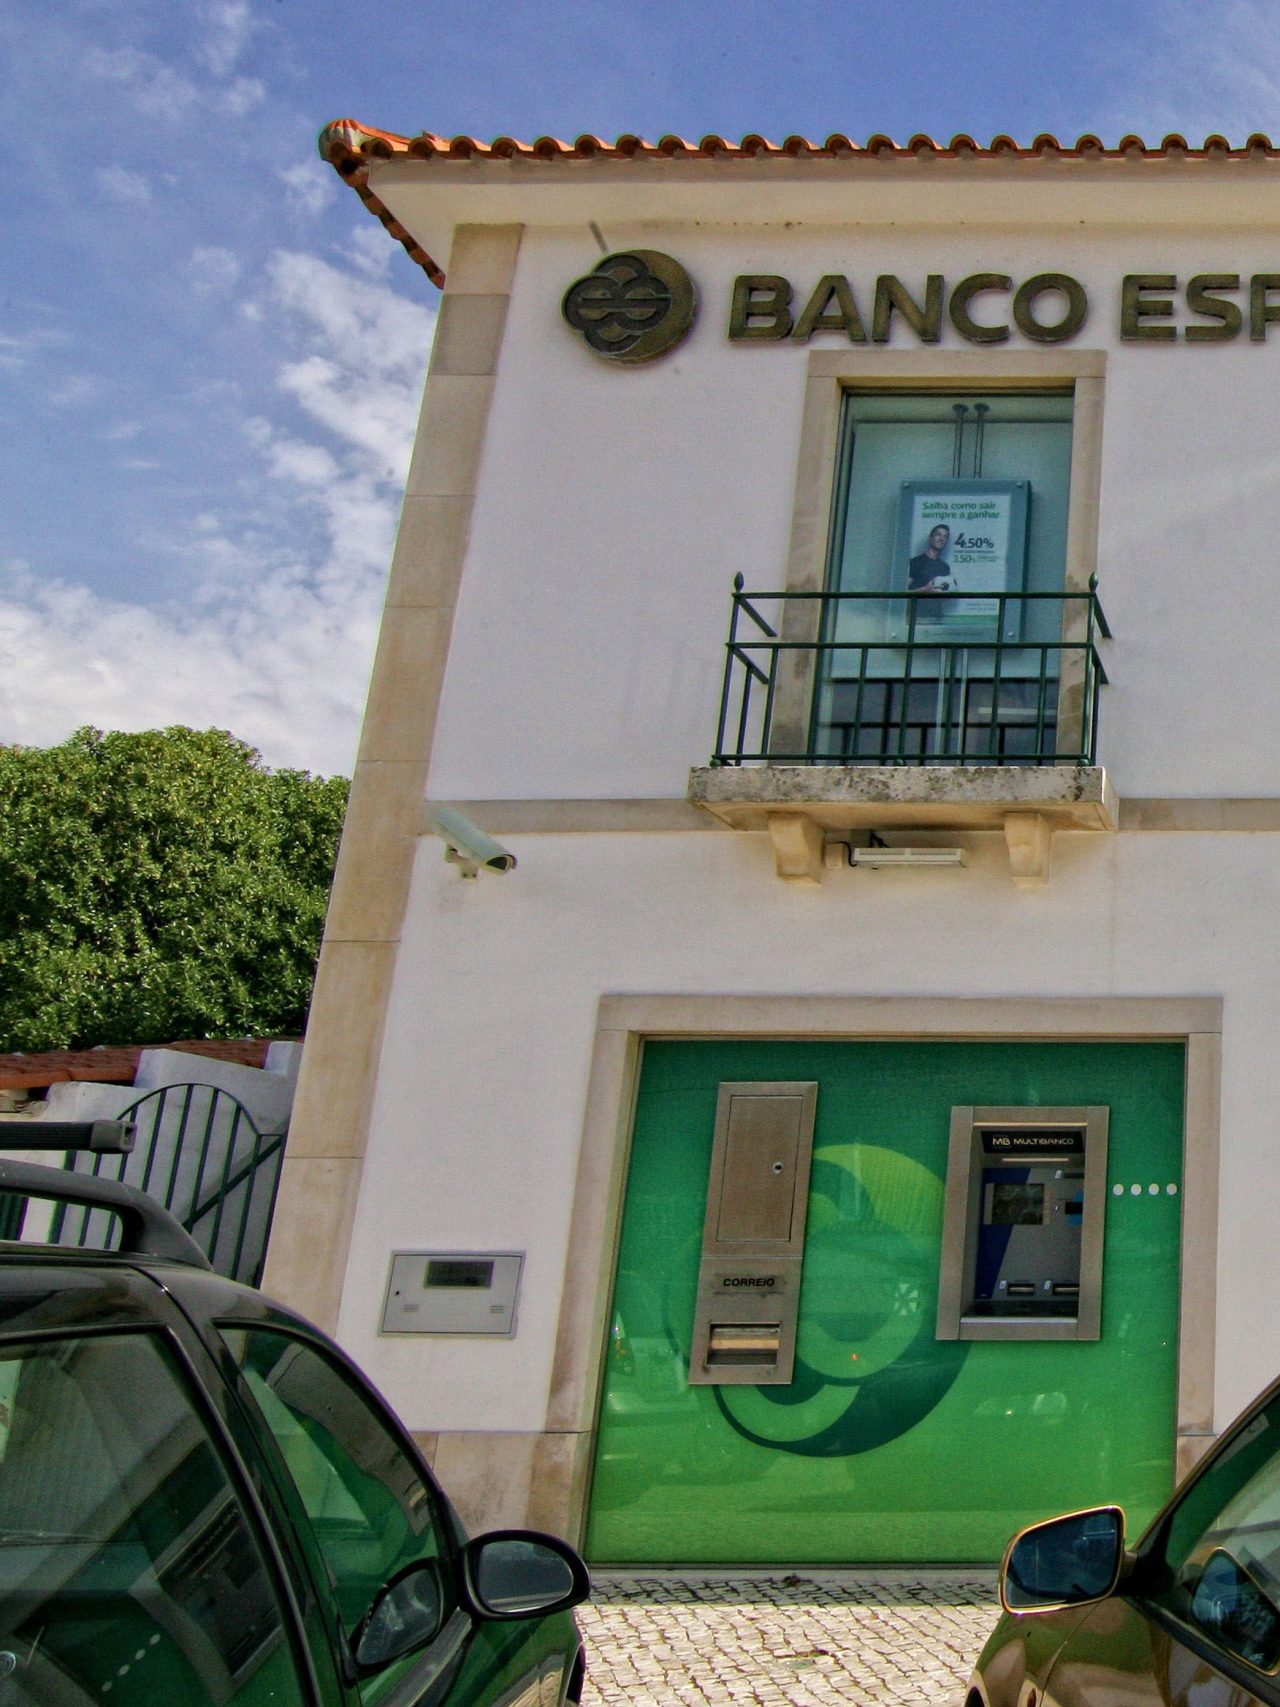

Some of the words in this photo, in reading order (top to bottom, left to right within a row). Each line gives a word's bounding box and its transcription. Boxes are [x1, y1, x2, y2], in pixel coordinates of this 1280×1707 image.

[727, 272, 1088, 343] BANCO
[922, 501, 949, 510] Saiba
[979, 501, 996, 510] sair
[921, 512, 958, 520] sempre
[967, 511, 1000, 520] ganhar
[992, 1137, 1011, 1146] MB
[723, 1278, 775, 1286] CORREIO
